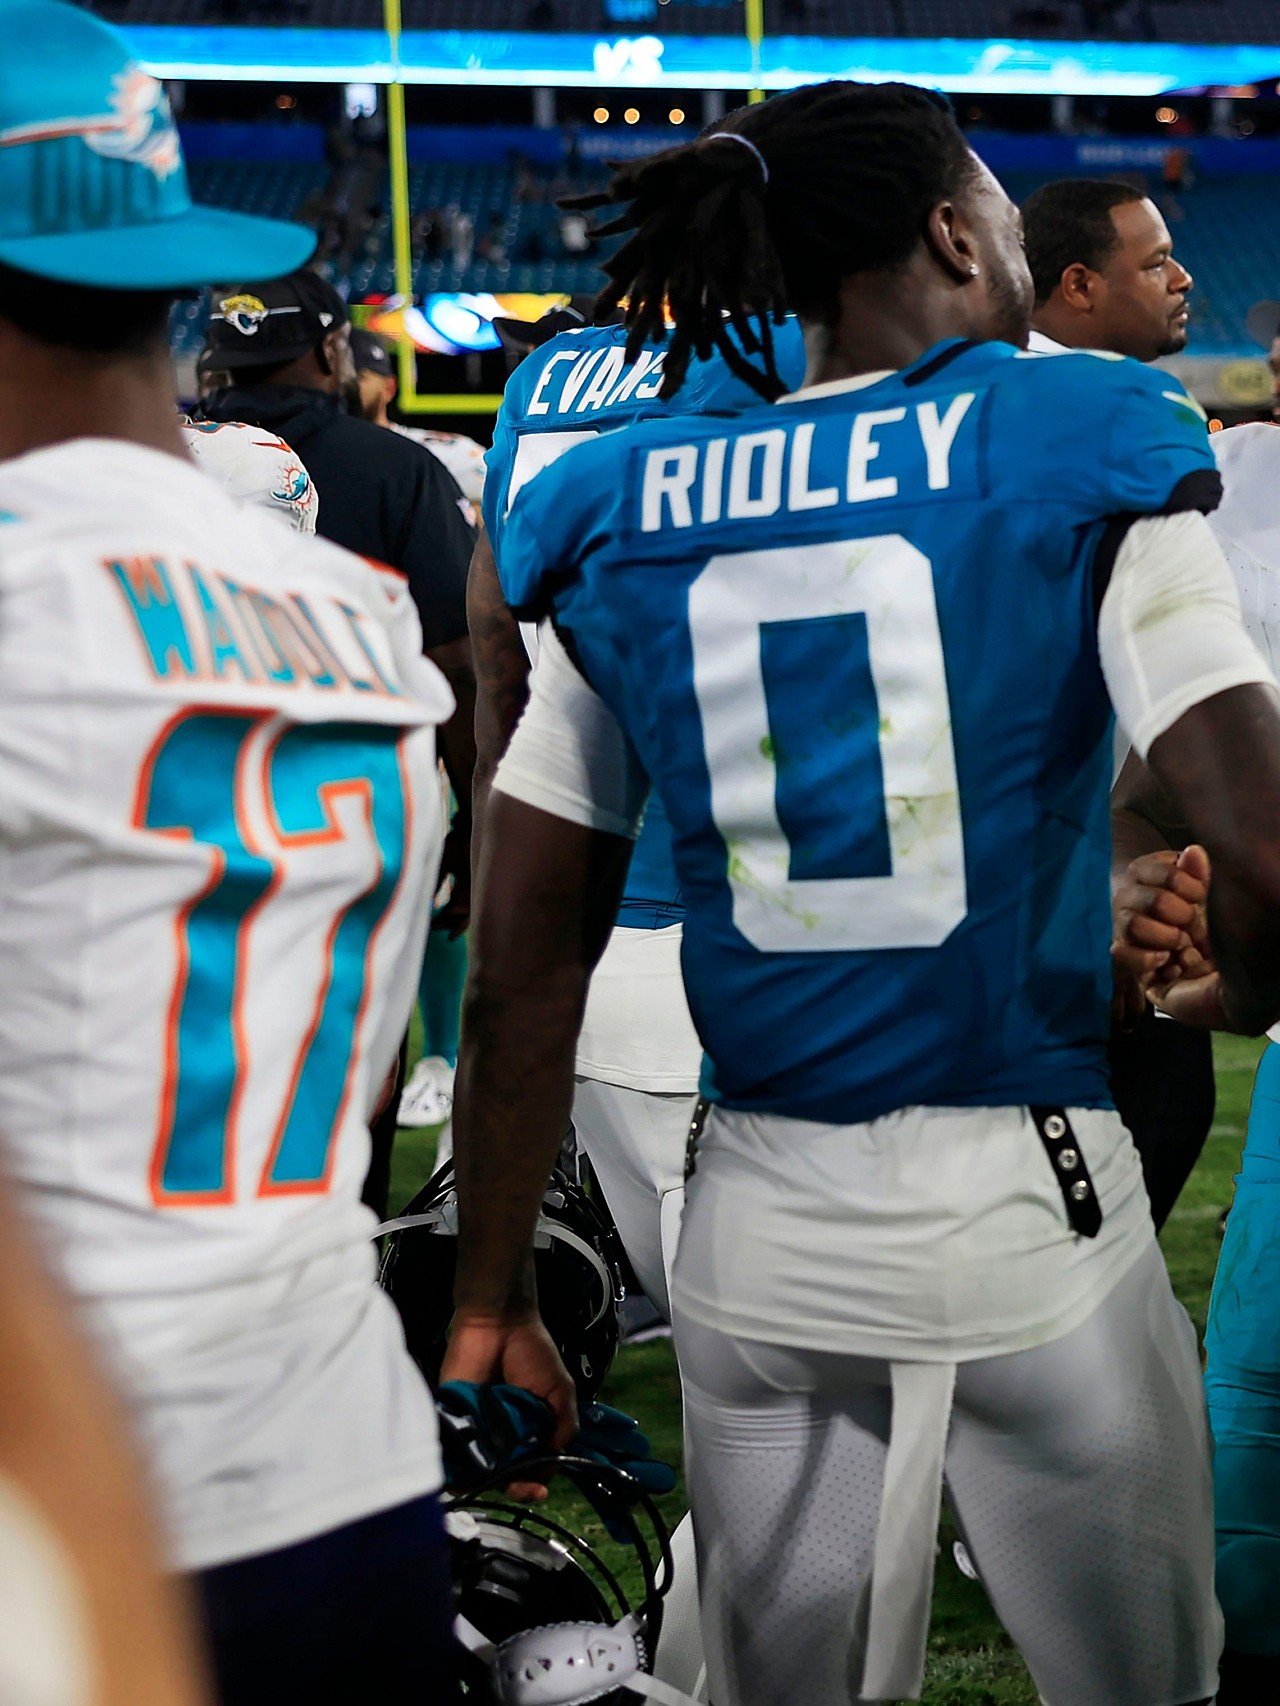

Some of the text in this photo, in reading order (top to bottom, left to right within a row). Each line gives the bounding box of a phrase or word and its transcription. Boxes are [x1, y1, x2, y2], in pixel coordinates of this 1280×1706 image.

[641, 392, 976, 533] RIDLEY
[688, 533, 968, 953] 0
[130, 703, 414, 1207] 17
